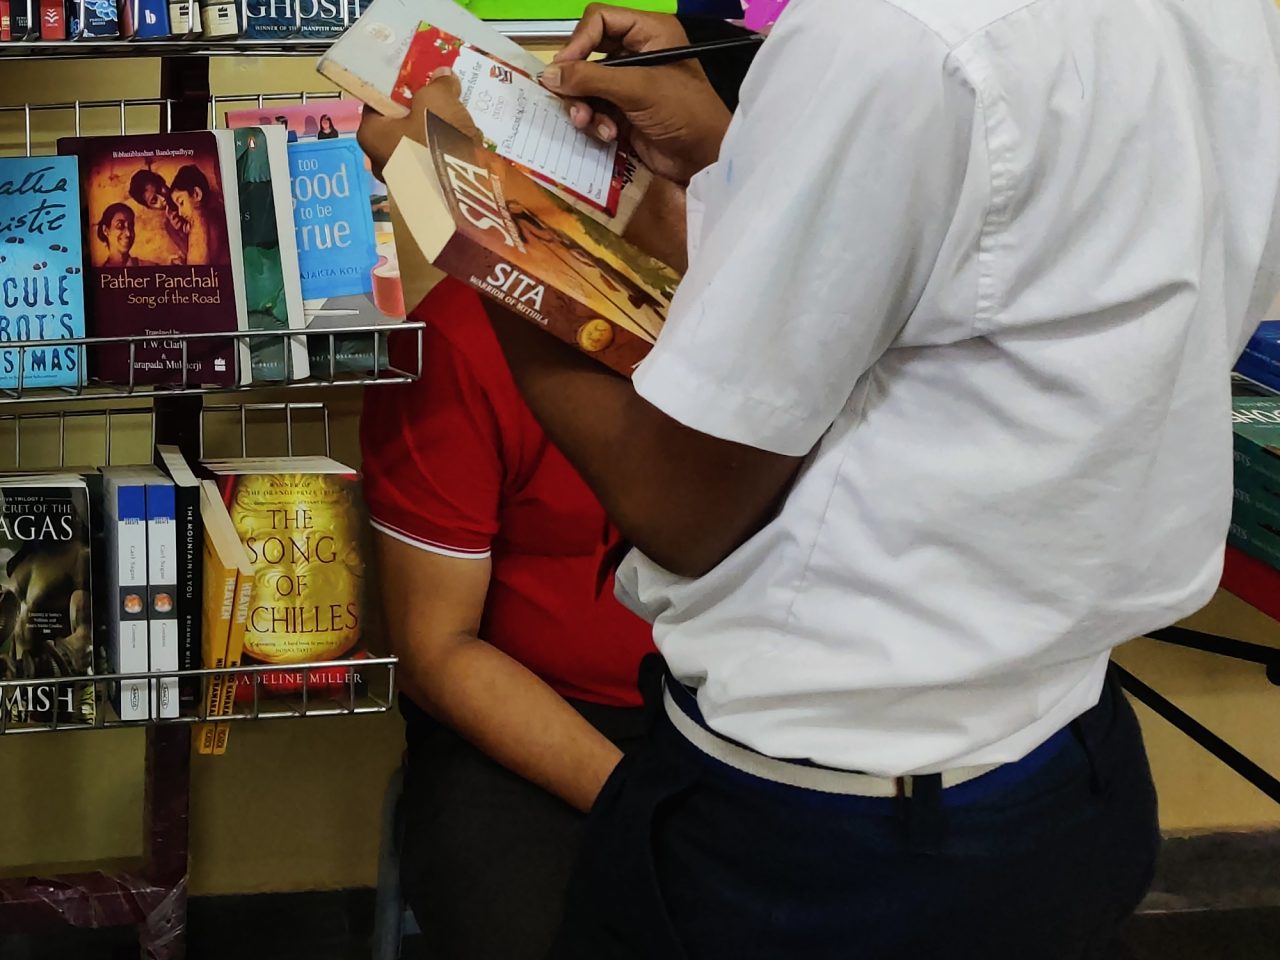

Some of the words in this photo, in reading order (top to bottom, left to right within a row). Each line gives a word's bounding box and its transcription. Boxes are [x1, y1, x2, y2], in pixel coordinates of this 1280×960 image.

[298, 158, 318, 172] too
[291, 162, 350, 210] ood
[443, 153, 515, 247] SITA
[301, 206, 313, 220] to
[316, 204, 332, 218] be
[296, 219, 352, 252] rue
[100, 272, 150, 289] Pather
[156, 271, 219, 288] Panchali
[486, 262, 544, 311] SITA
[128, 293, 156, 308] Song
[158, 292, 170, 304] of
[171, 292, 190, 304] the
[192, 292, 220, 304] Road
[470, 274, 506, 299] WARRIOR
[504, 294, 516, 306] OF
[516, 302, 548, 326] MITHILA
[34, 504, 48, 514] OF
[50, 504, 72, 514] THE
[266, 509, 314, 530] THE
[246, 536, 336, 564] SONG
[186, 572, 193, 580] IS
[276, 575, 307, 596] OF
[245, 602, 358, 634] CHILLES
